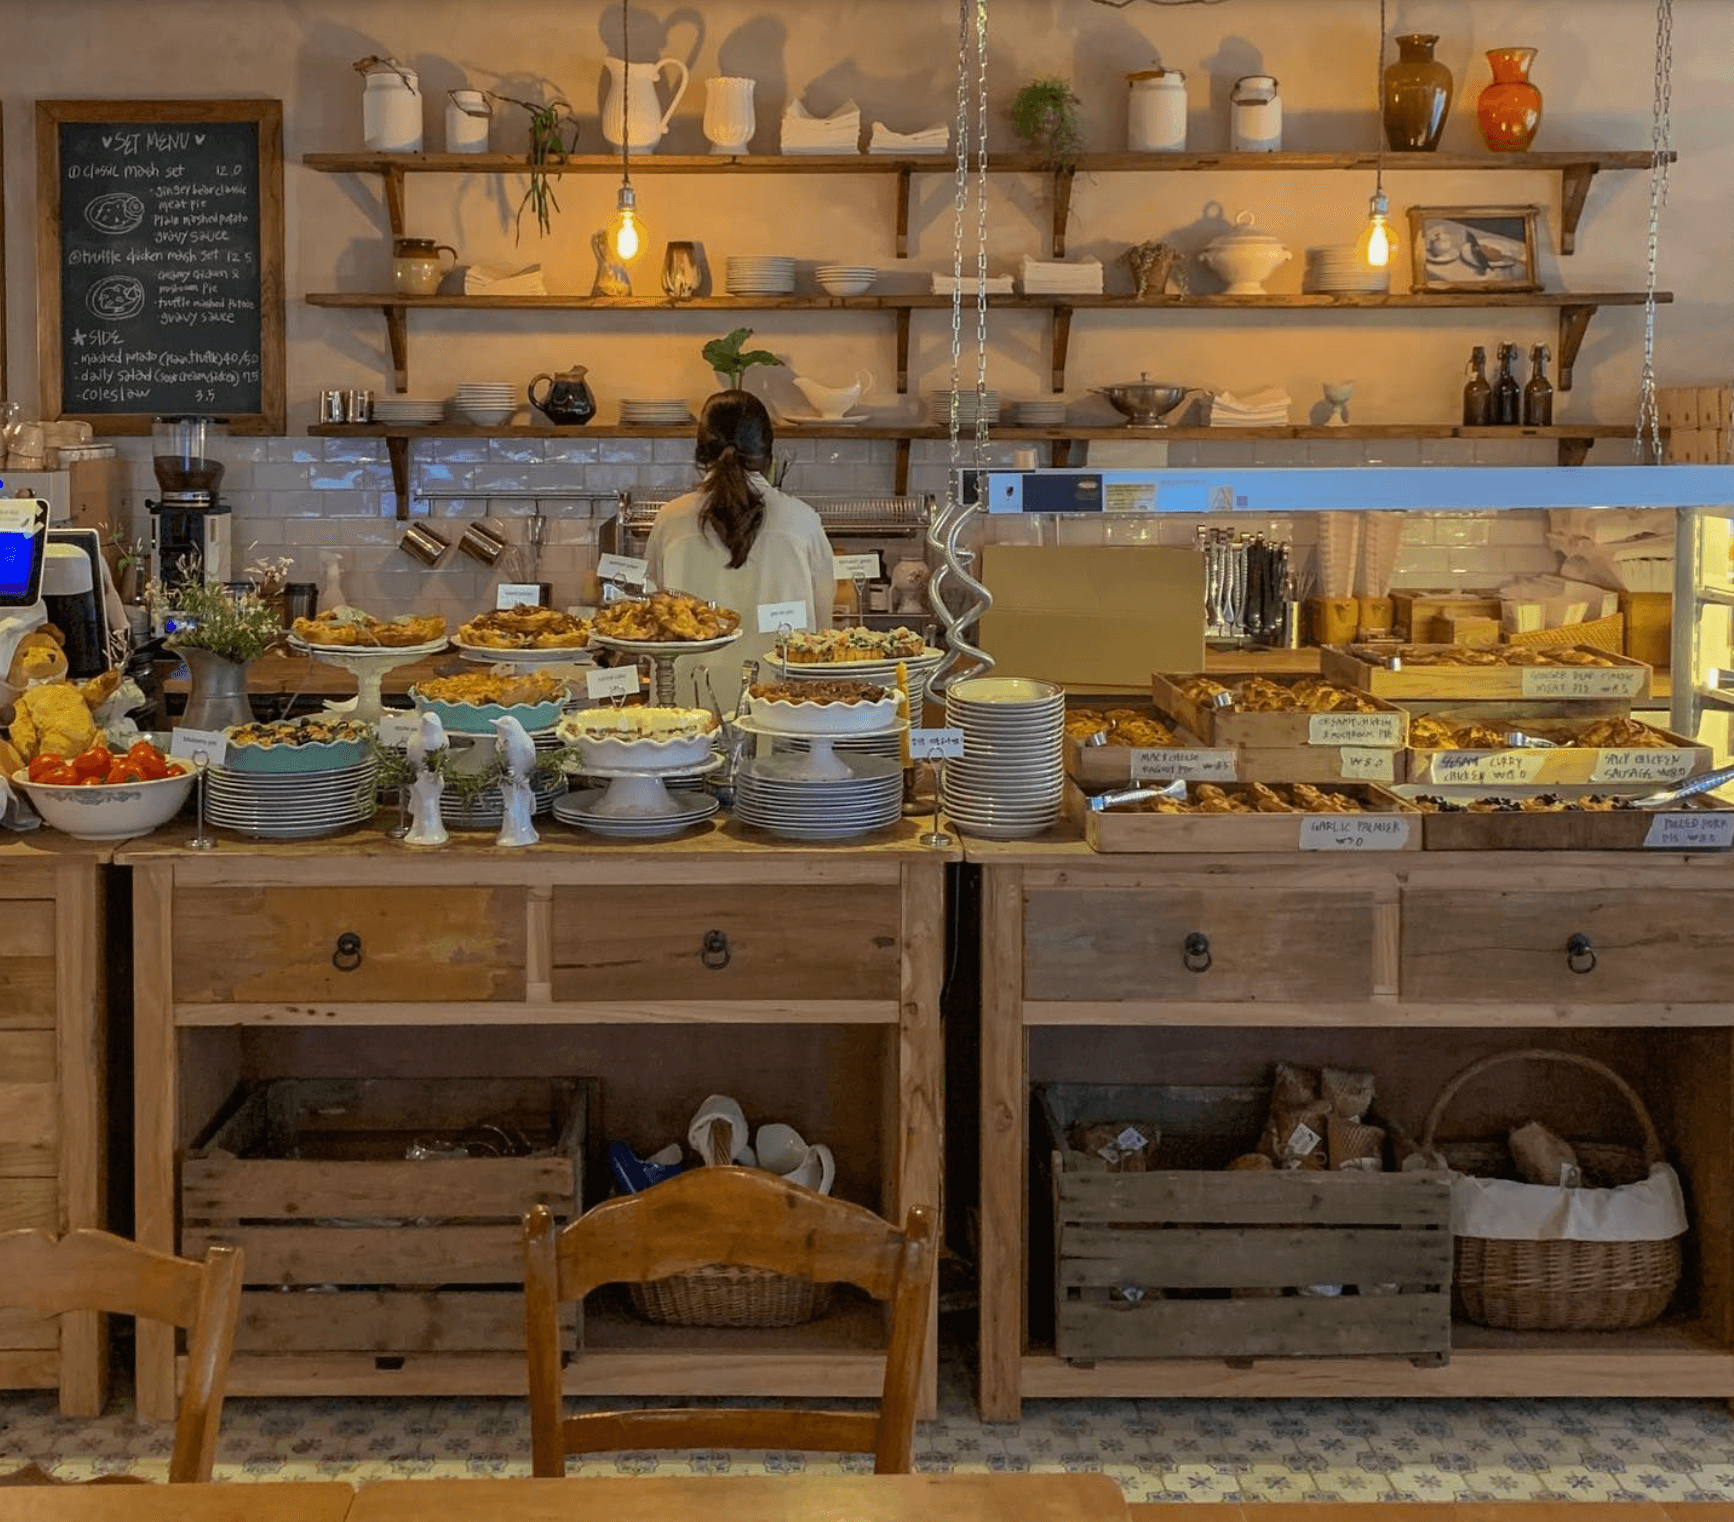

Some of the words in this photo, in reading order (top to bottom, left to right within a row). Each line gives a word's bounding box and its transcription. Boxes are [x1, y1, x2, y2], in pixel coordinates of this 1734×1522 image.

[114, 132, 140, 155] SET
[146, 132, 190, 152] MENU
[165, 164, 185, 178] set
[155, 230, 188, 245] gravy
[190, 230, 229, 243] sauce
[200, 249, 219, 262] set
[160, 312, 197, 326] gravy
[201, 312, 235, 323] sauce
[89, 330, 125, 346] SIDE
[81, 368, 113, 384] daily
[117, 367, 152, 382] salad
[1311, 820, 1350, 832] GARLIC
